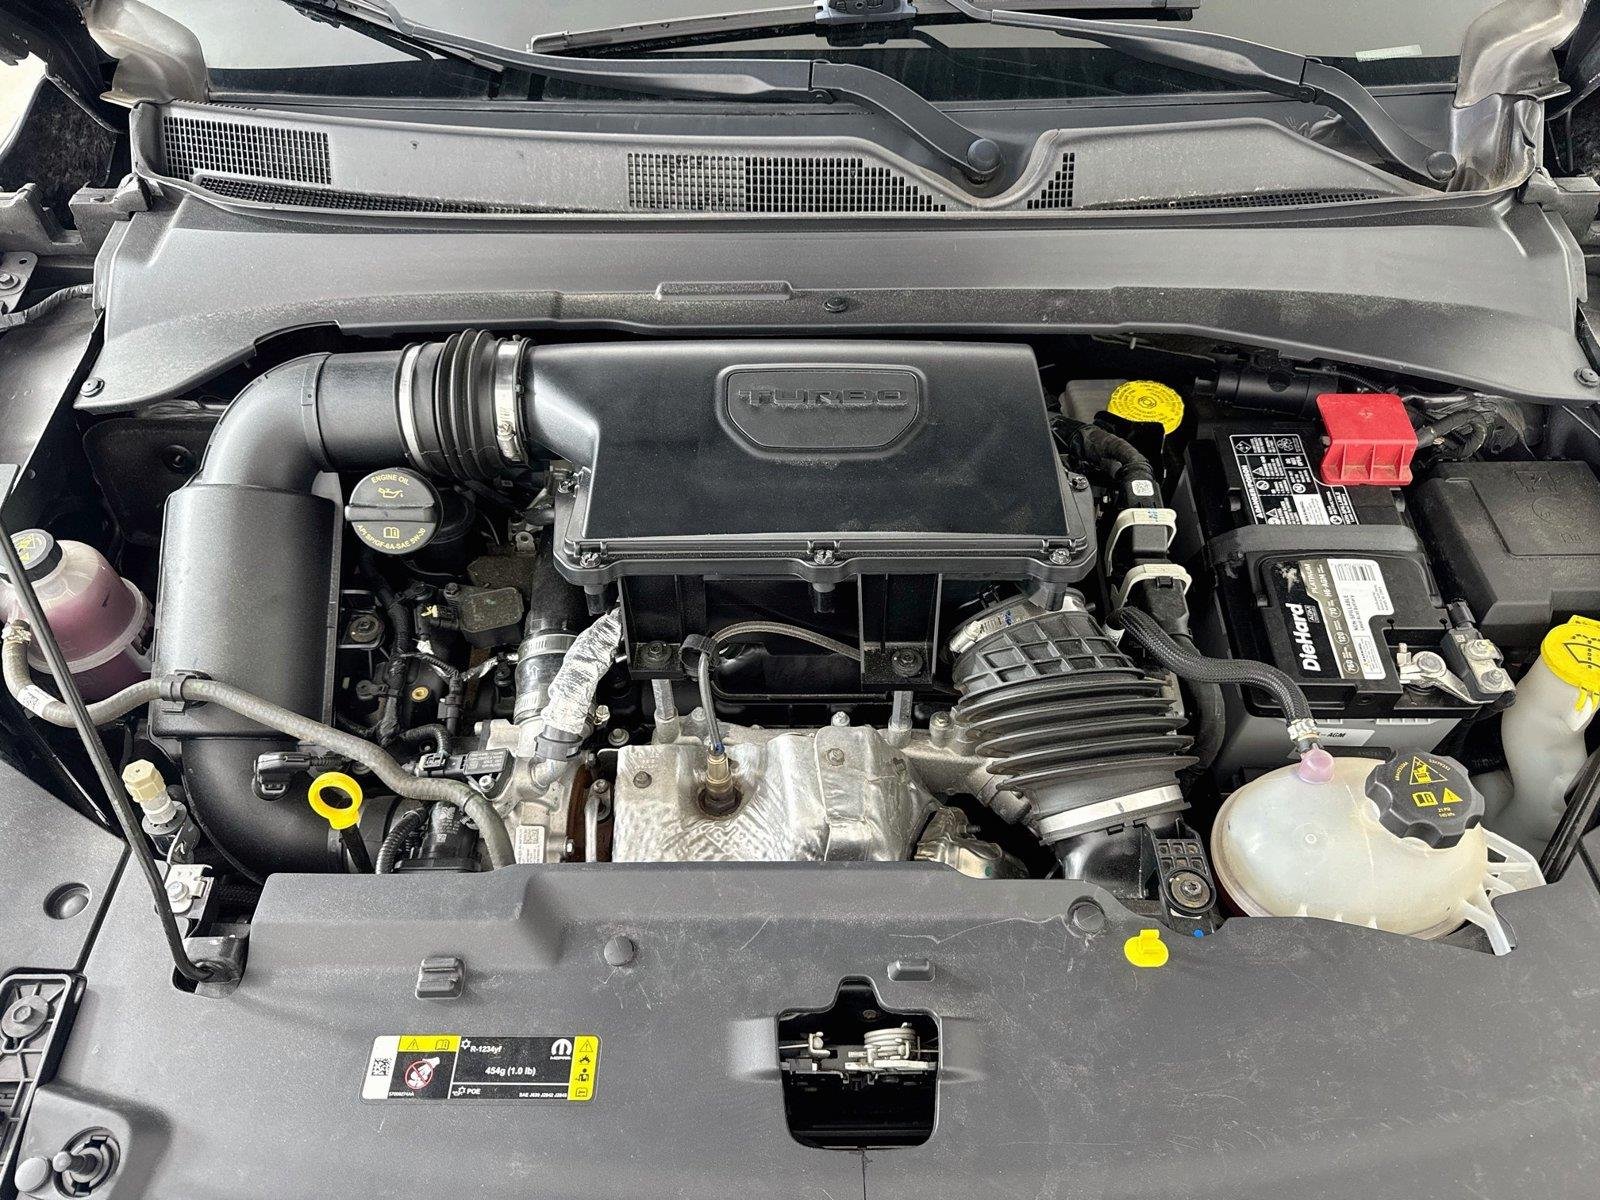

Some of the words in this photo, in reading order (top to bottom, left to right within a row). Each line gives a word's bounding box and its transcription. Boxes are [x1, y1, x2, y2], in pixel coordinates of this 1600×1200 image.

[738, 388, 908, 407] TURBO
[371, 473, 397, 485] ENGINE
[398, 475, 409, 486] OIL
[357, 524, 367, 537] API
[1284, 602, 1321, 670] DieHard
[470, 1045, 503, 1054] R-1234yf
[485, 1067, 505, 1077] 454g
[507, 1067, 523, 1077] (1.0
[525, 1067, 536, 1077] lb)
